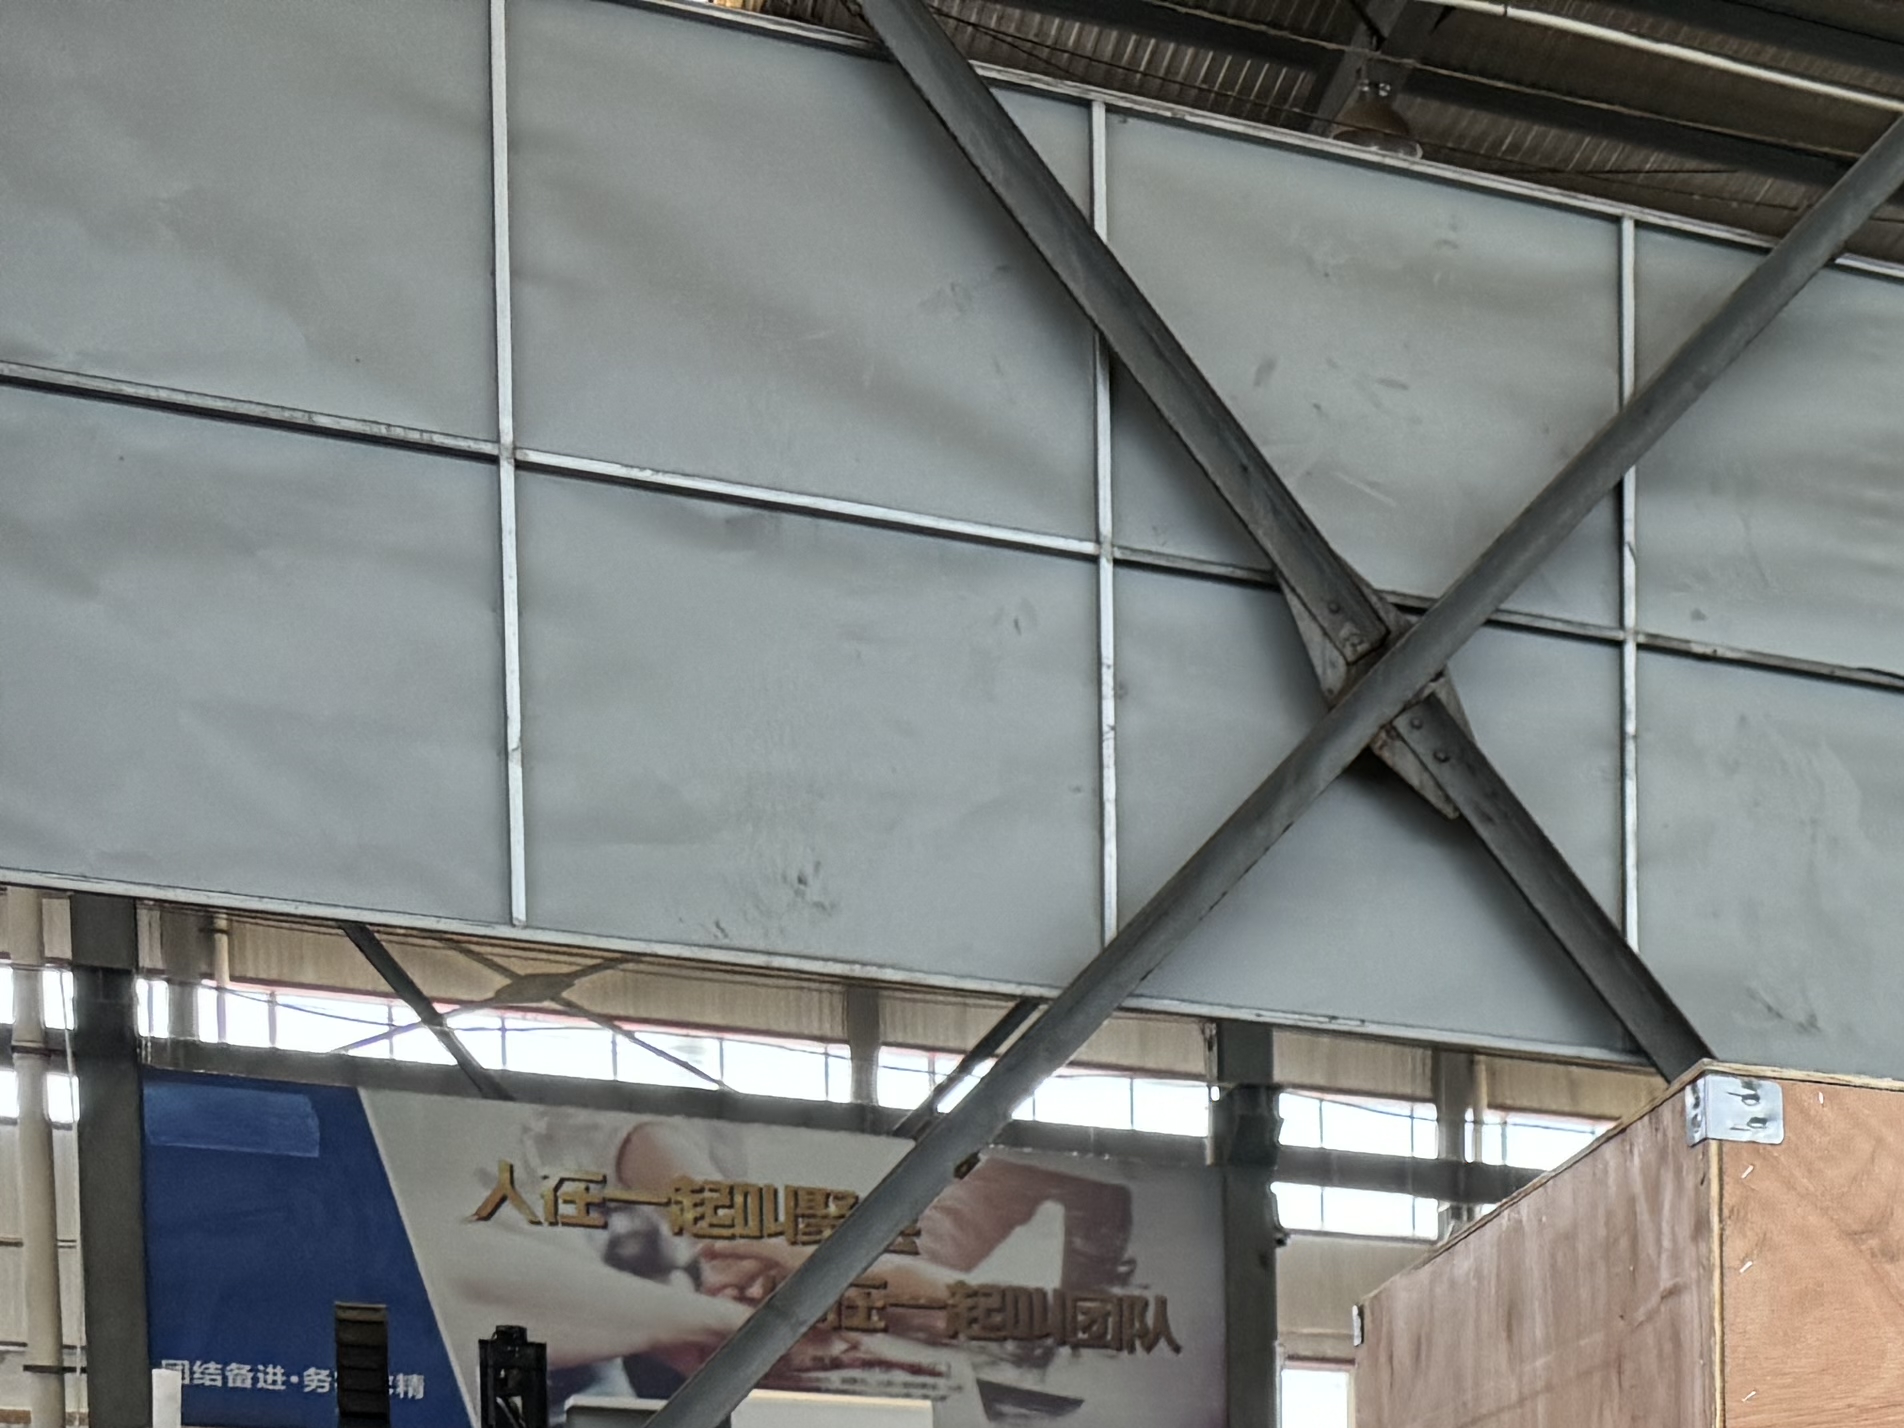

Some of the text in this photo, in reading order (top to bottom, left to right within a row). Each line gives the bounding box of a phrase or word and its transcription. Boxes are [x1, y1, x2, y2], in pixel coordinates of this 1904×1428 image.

[463, 1160, 922, 1255] 人在一起叫聚
